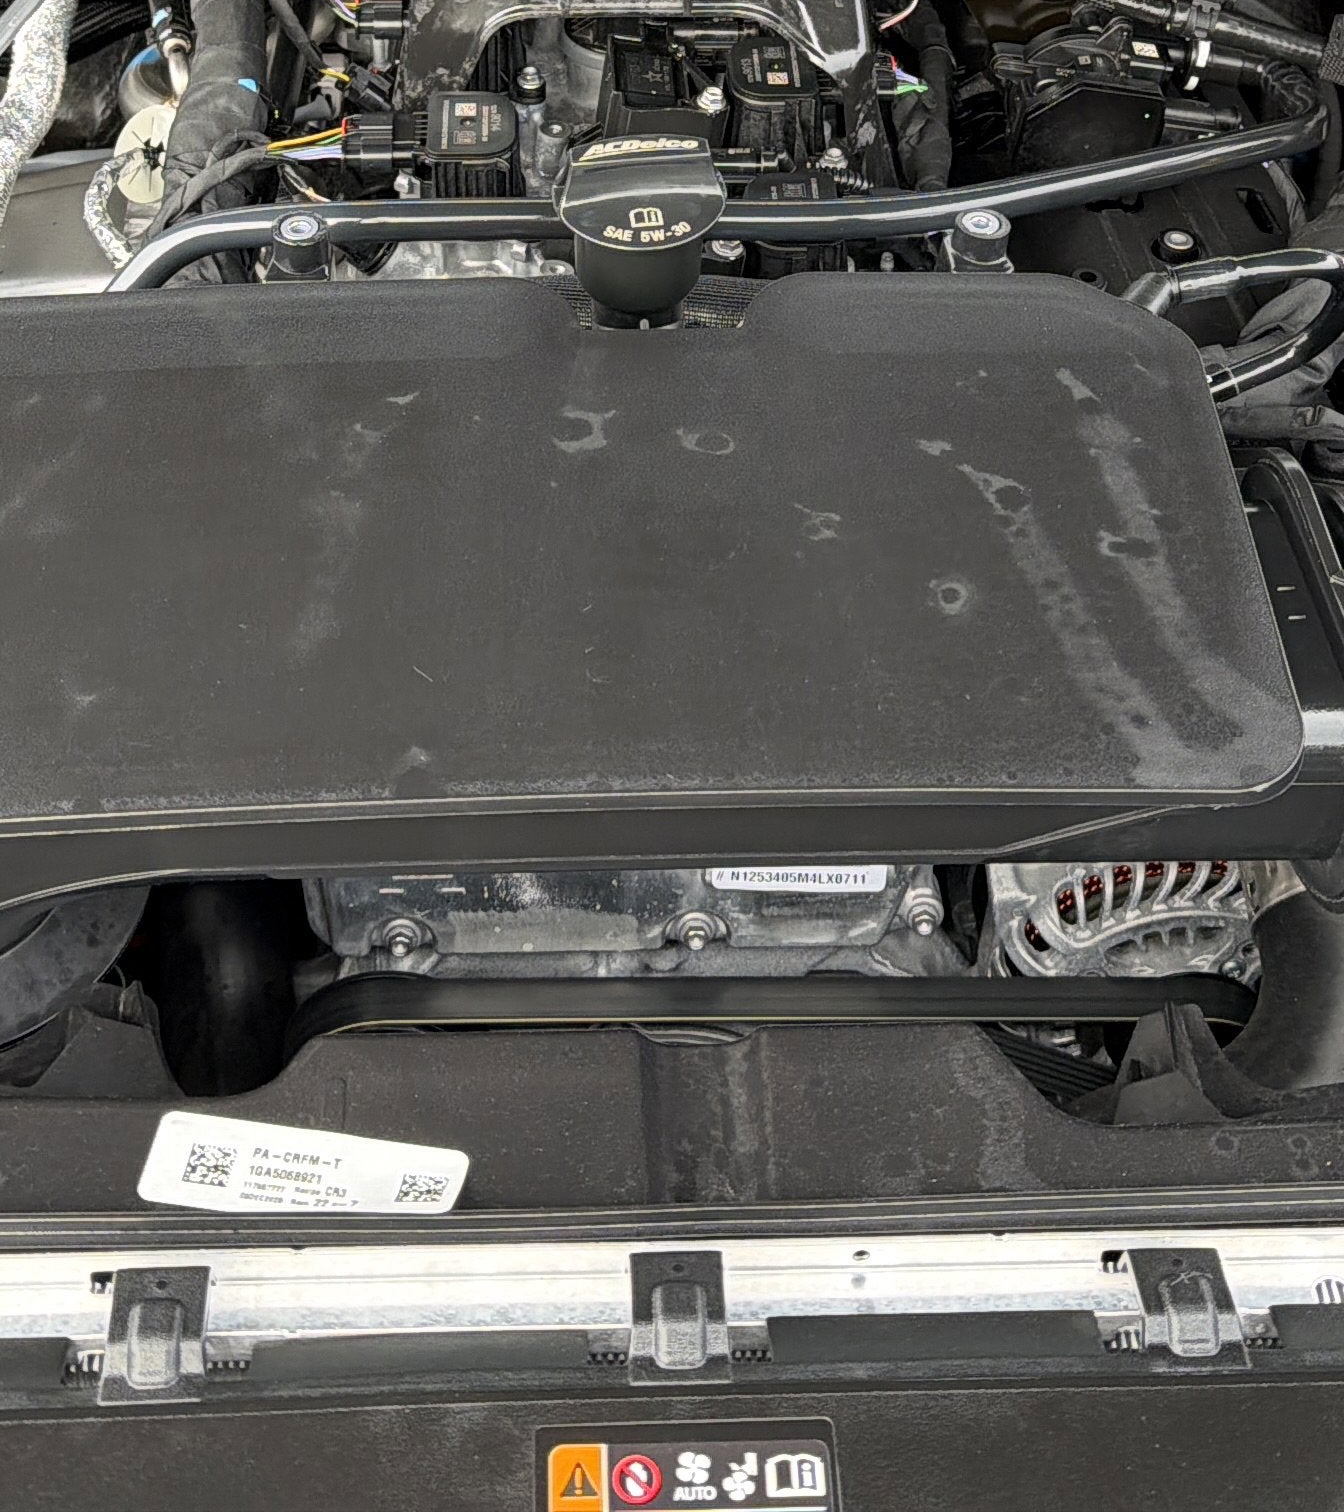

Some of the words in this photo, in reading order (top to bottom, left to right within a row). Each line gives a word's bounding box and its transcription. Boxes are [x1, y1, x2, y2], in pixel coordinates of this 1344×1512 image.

[581, 138, 699, 159] ACDelco
[602, 225, 634, 242] SAE
[640, 221, 692, 243] 5W-30
[672, 1485, 718, 1501] AUTO
